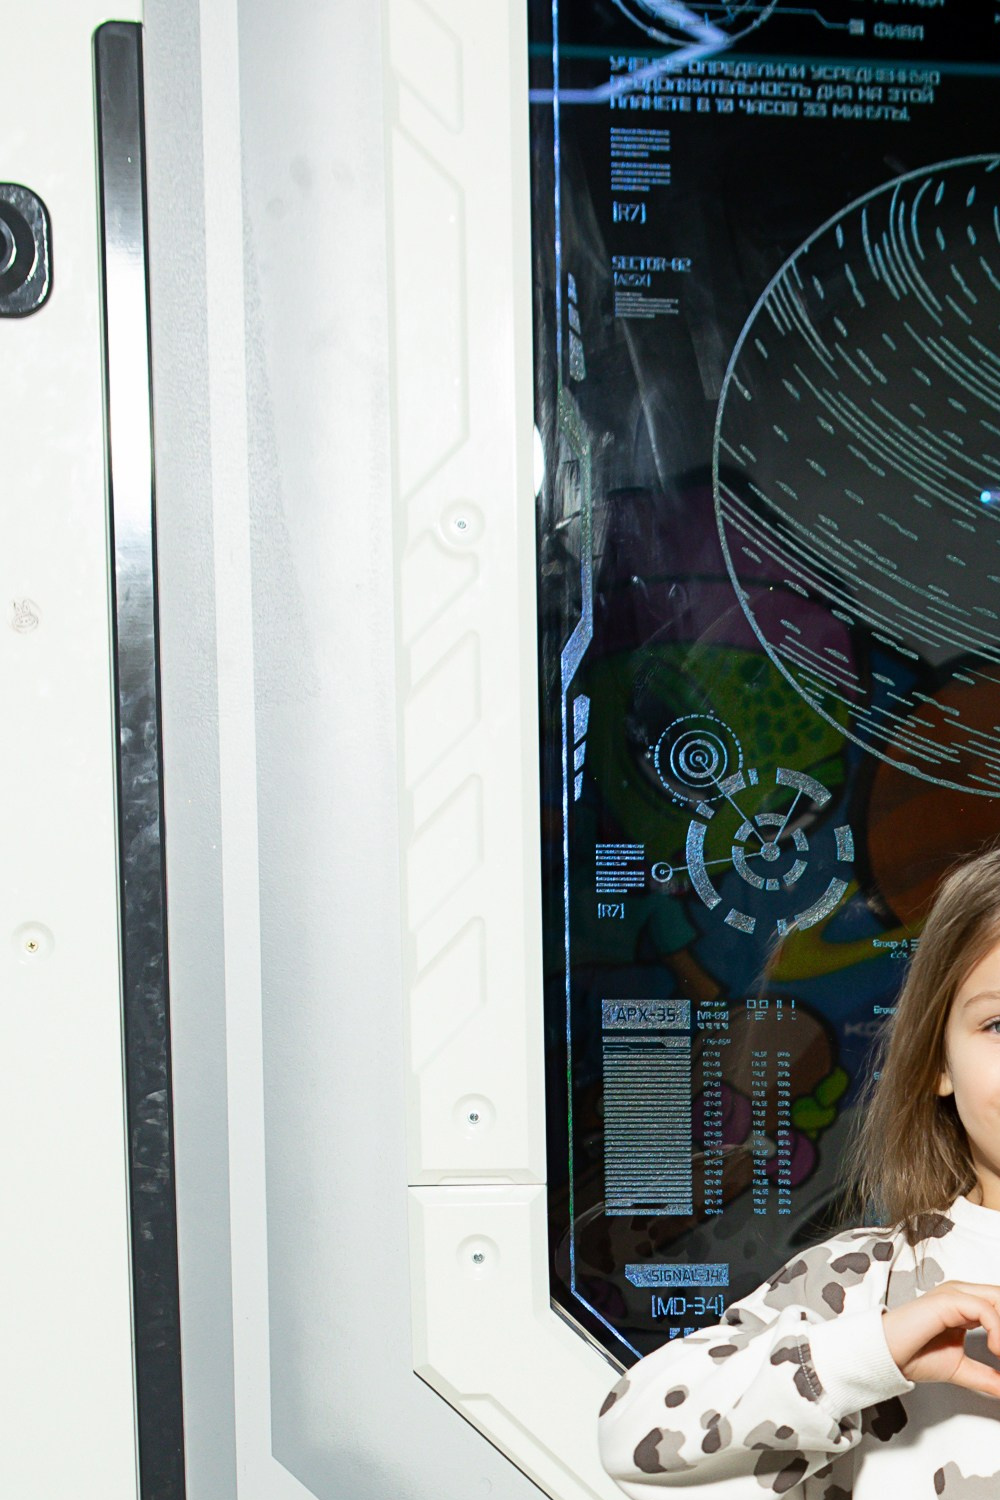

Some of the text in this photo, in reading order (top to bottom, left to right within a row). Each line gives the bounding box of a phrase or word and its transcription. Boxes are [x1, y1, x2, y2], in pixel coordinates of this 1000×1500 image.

[612, 201, 646, 224] [R7]
[597, 902, 625, 920] [R7]
[616, 1007, 677, 1023] APX-35
[651, 1269, 720, 1282] SIGNAL-14
[651, 1294, 724, 1318] [MD-34]
